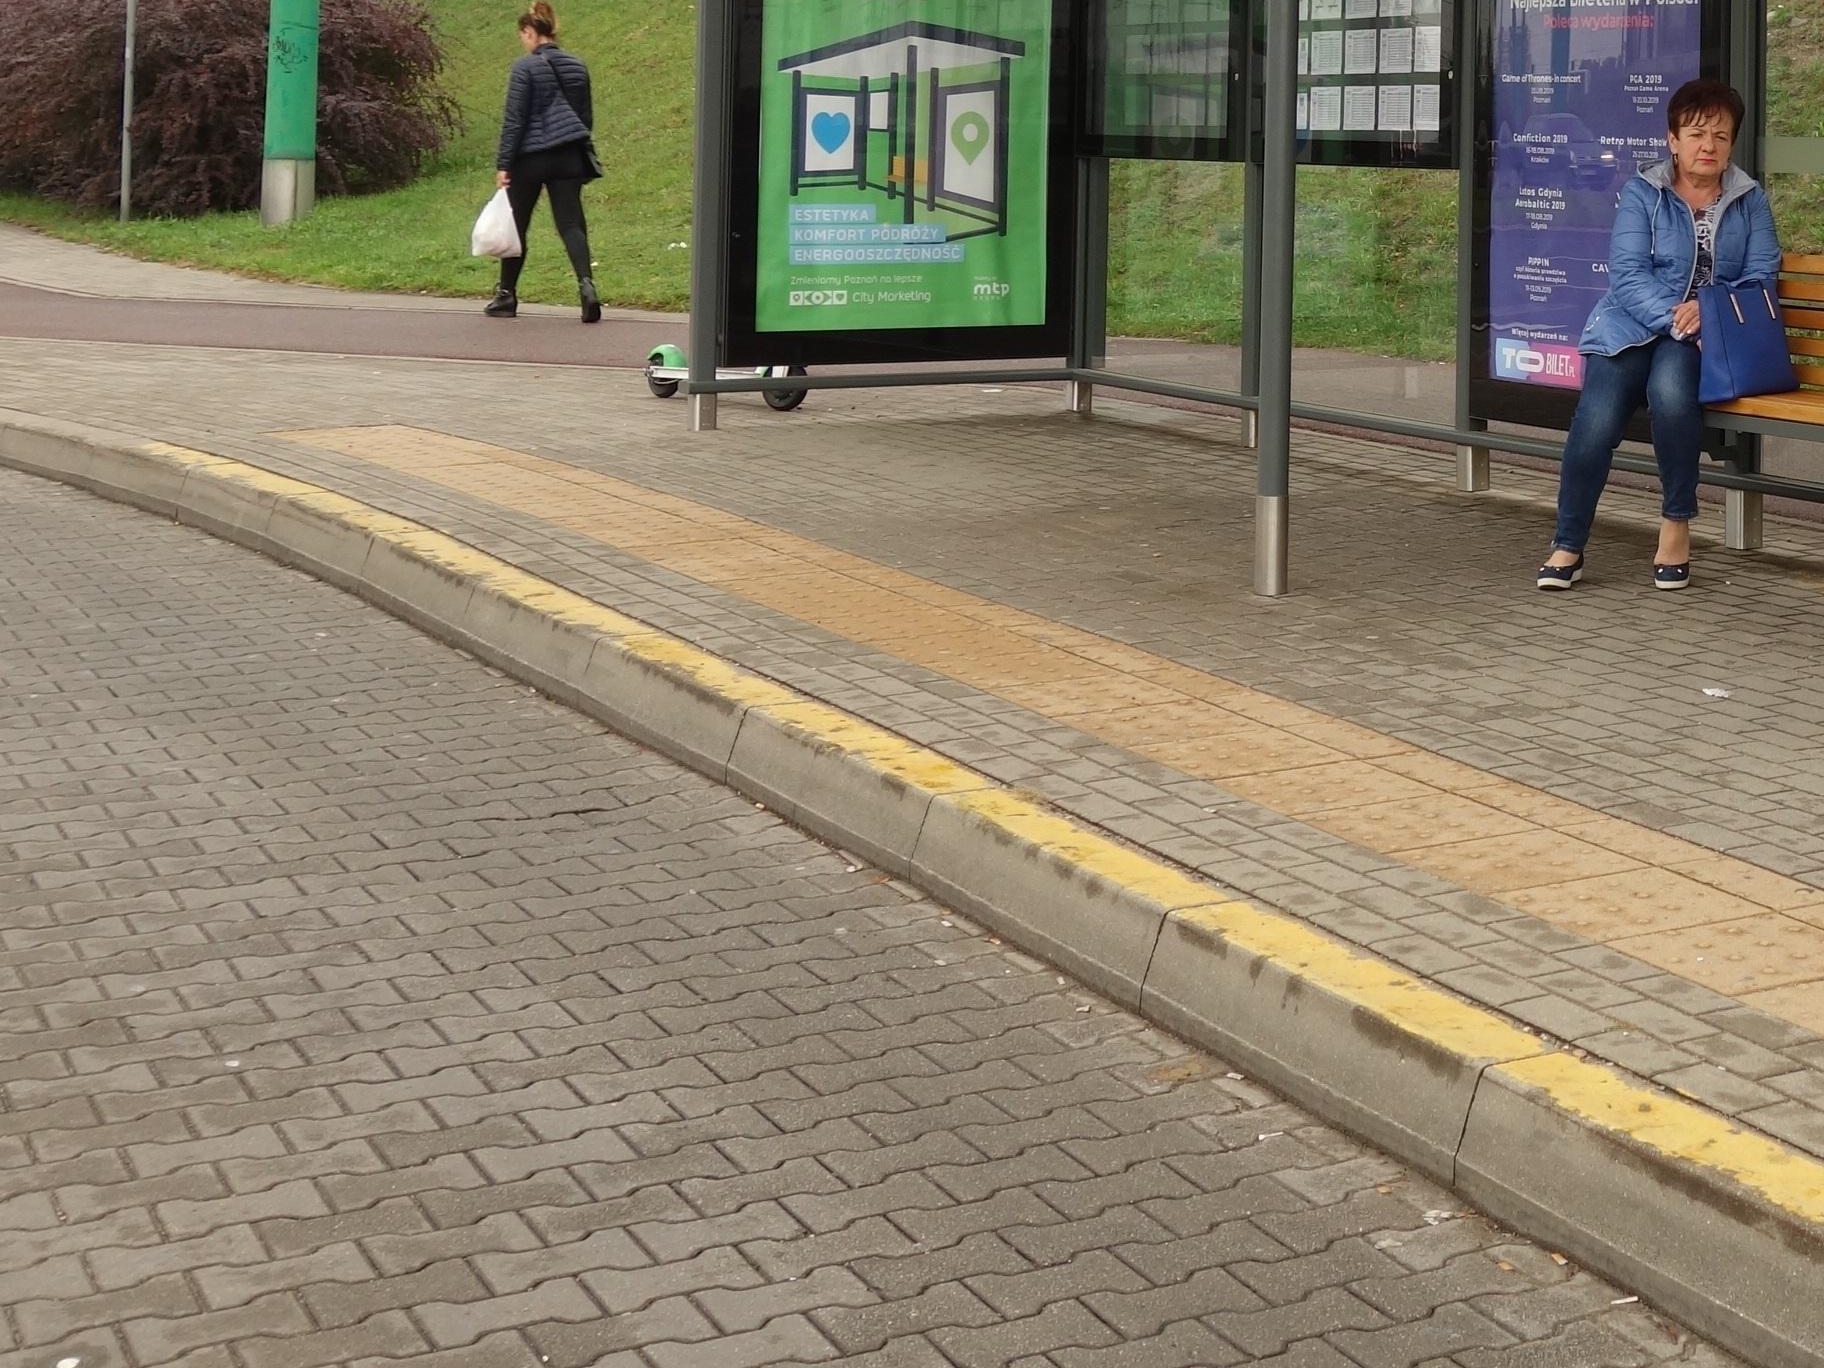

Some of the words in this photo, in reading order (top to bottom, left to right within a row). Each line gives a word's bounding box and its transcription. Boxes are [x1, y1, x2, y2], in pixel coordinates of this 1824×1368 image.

[1501, 74, 1520, 83] Game
[1629, 75, 1642, 83] PGA
[1645, 75, 1663, 84] 2019
[1553, 134, 1568, 143] 2019
[1600, 136, 1625, 145] Retro
[1627, 137, 1647, 146] Motor
[1649, 137, 1667, 147] Show
[1538, 188, 1562, 199] Gdynia
[1551, 200, 1566, 210] 2019
[794, 209, 870, 221] ESTETYKA
[794, 229, 866, 241] KOMFORT
[871, 226, 938, 241] PODRÓŻY
[794, 245, 961, 262] ENERGOOSZCZĘDNOŚĆ
[1528, 257, 1549, 267] PIPPIN
[973, 282, 1010, 296] mtp
[852, 291, 875, 304] City
[877, 290, 932, 304] Marketing
